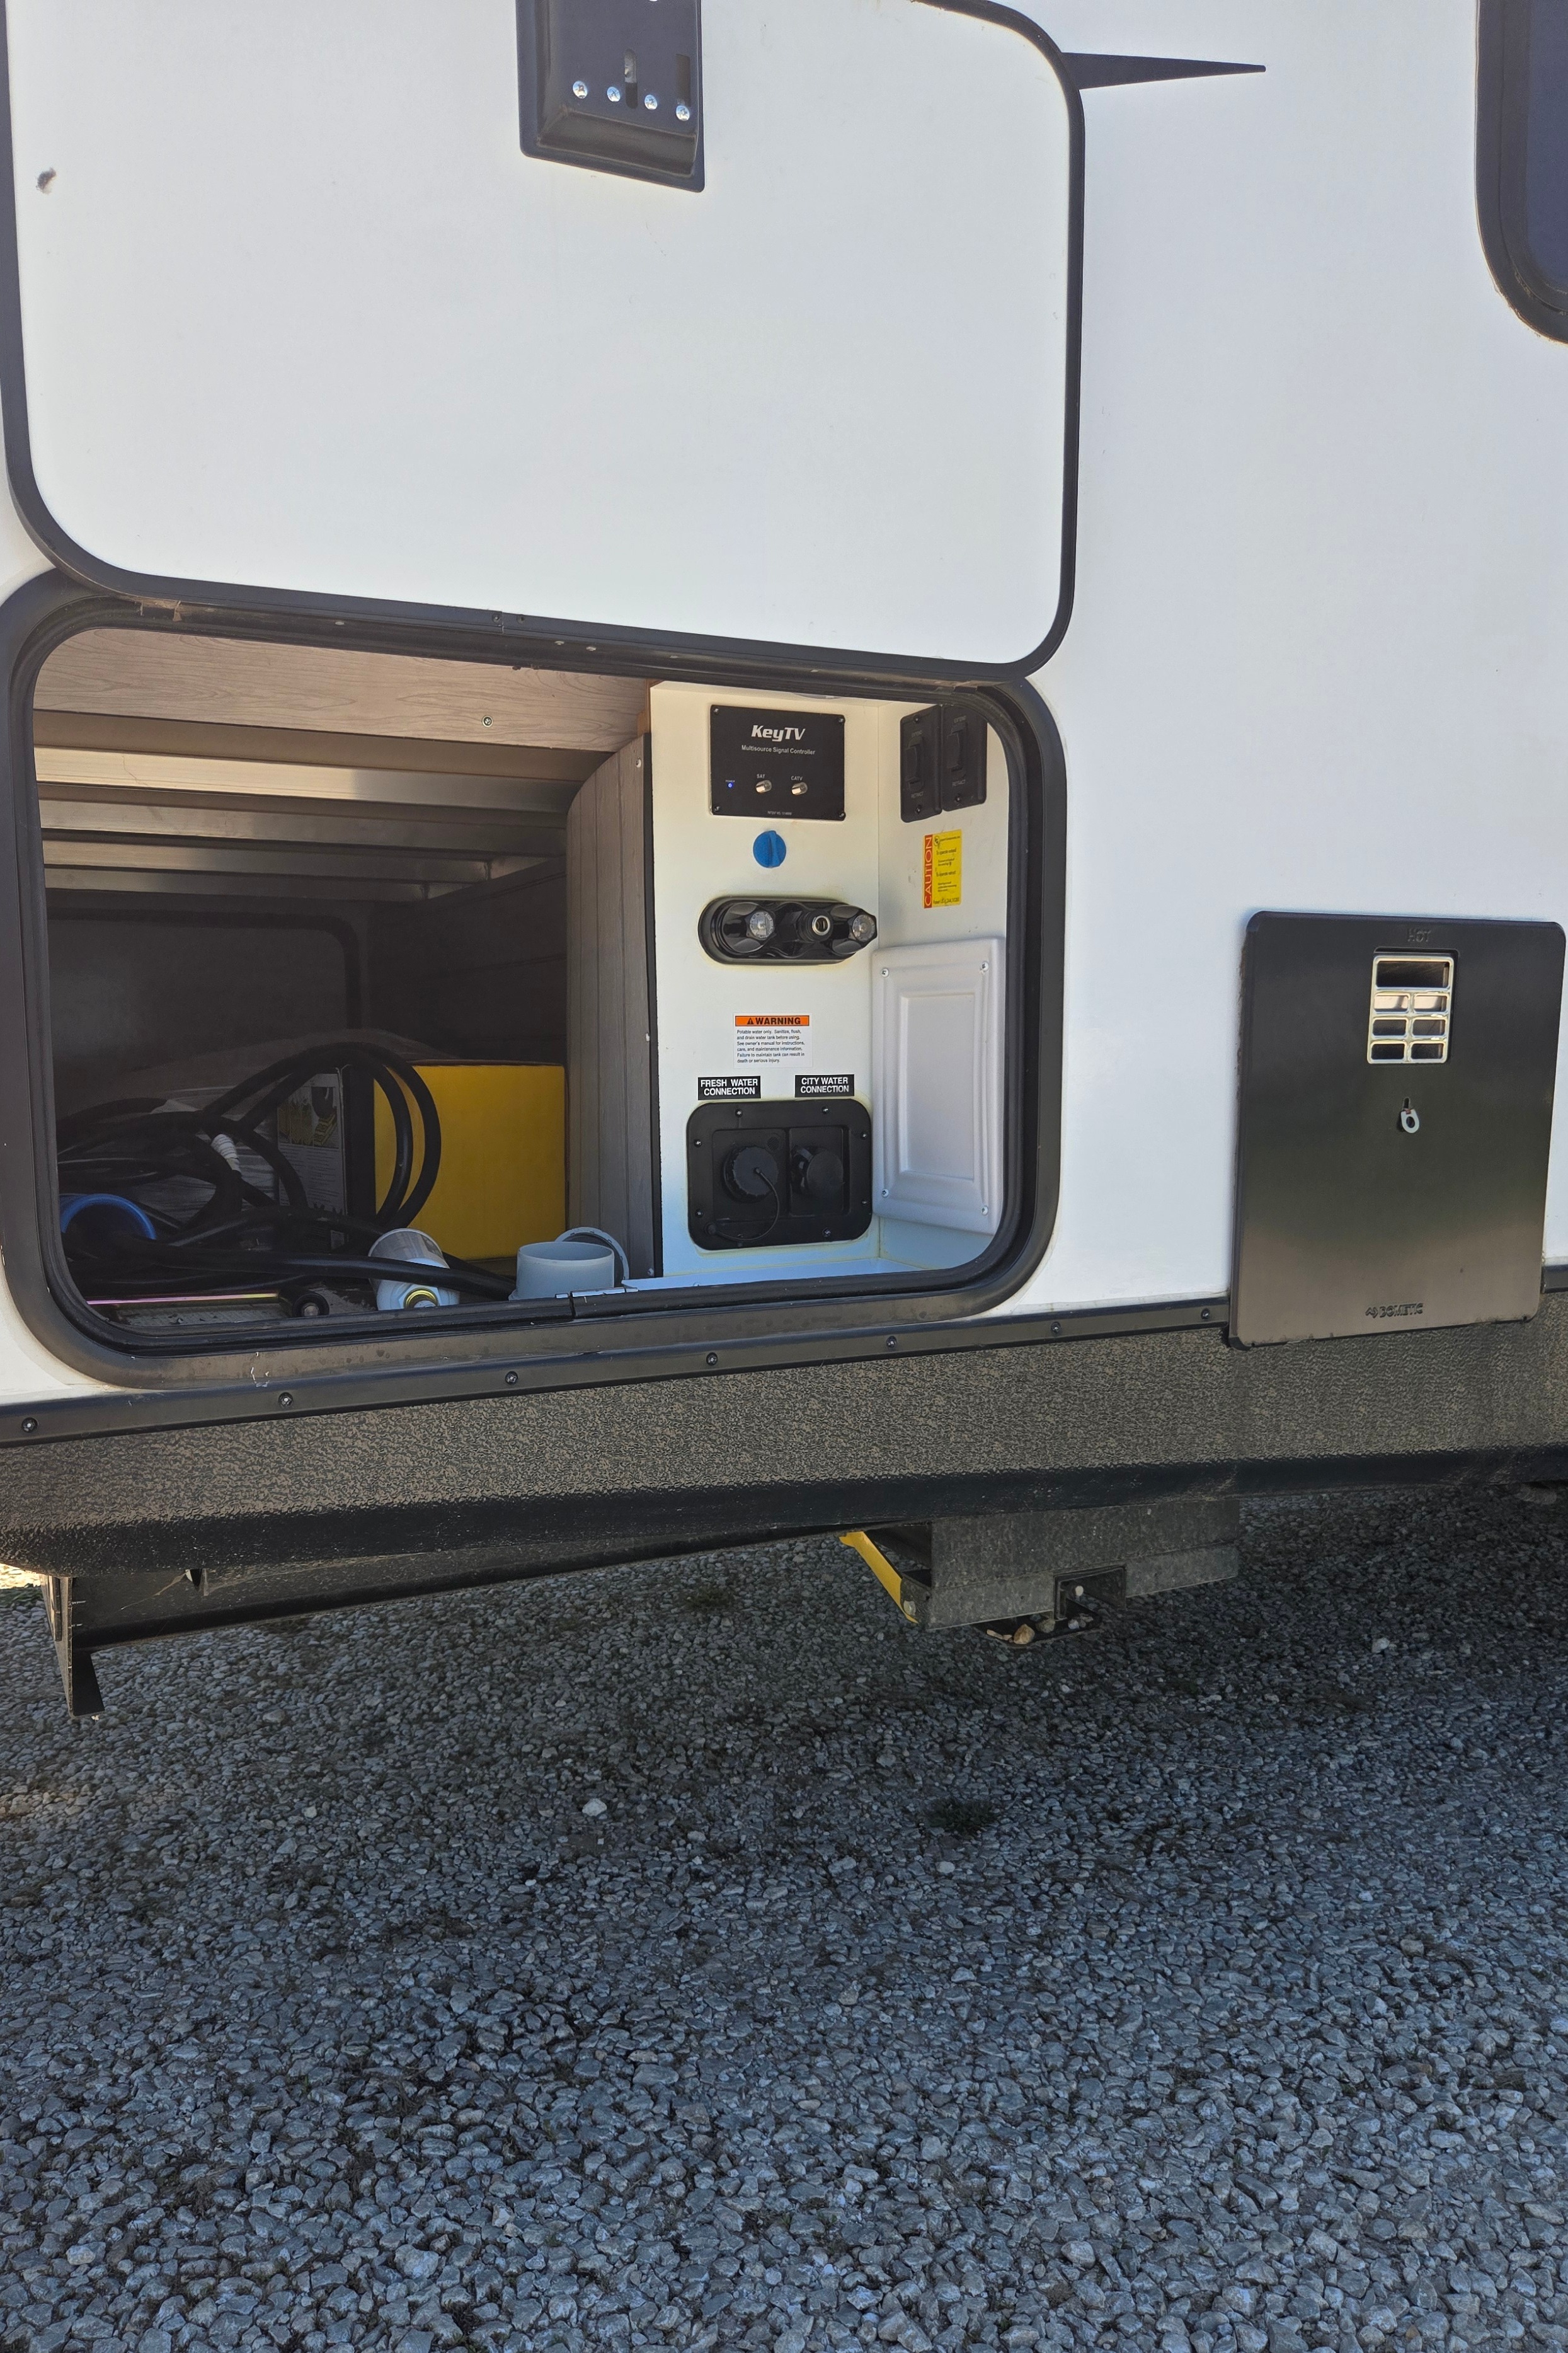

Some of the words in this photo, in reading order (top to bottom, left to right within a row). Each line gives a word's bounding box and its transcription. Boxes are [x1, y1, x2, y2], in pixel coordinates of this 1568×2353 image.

[751, 725, 806, 742] KeyTV
[772, 747, 789, 755] Signal
[701, 1079, 726, 1088] FRESH
[730, 1079, 758, 1087] WATER
[704, 1087, 755, 1096] CONNECTION
[800, 1085, 849, 1093] CONNECTION
